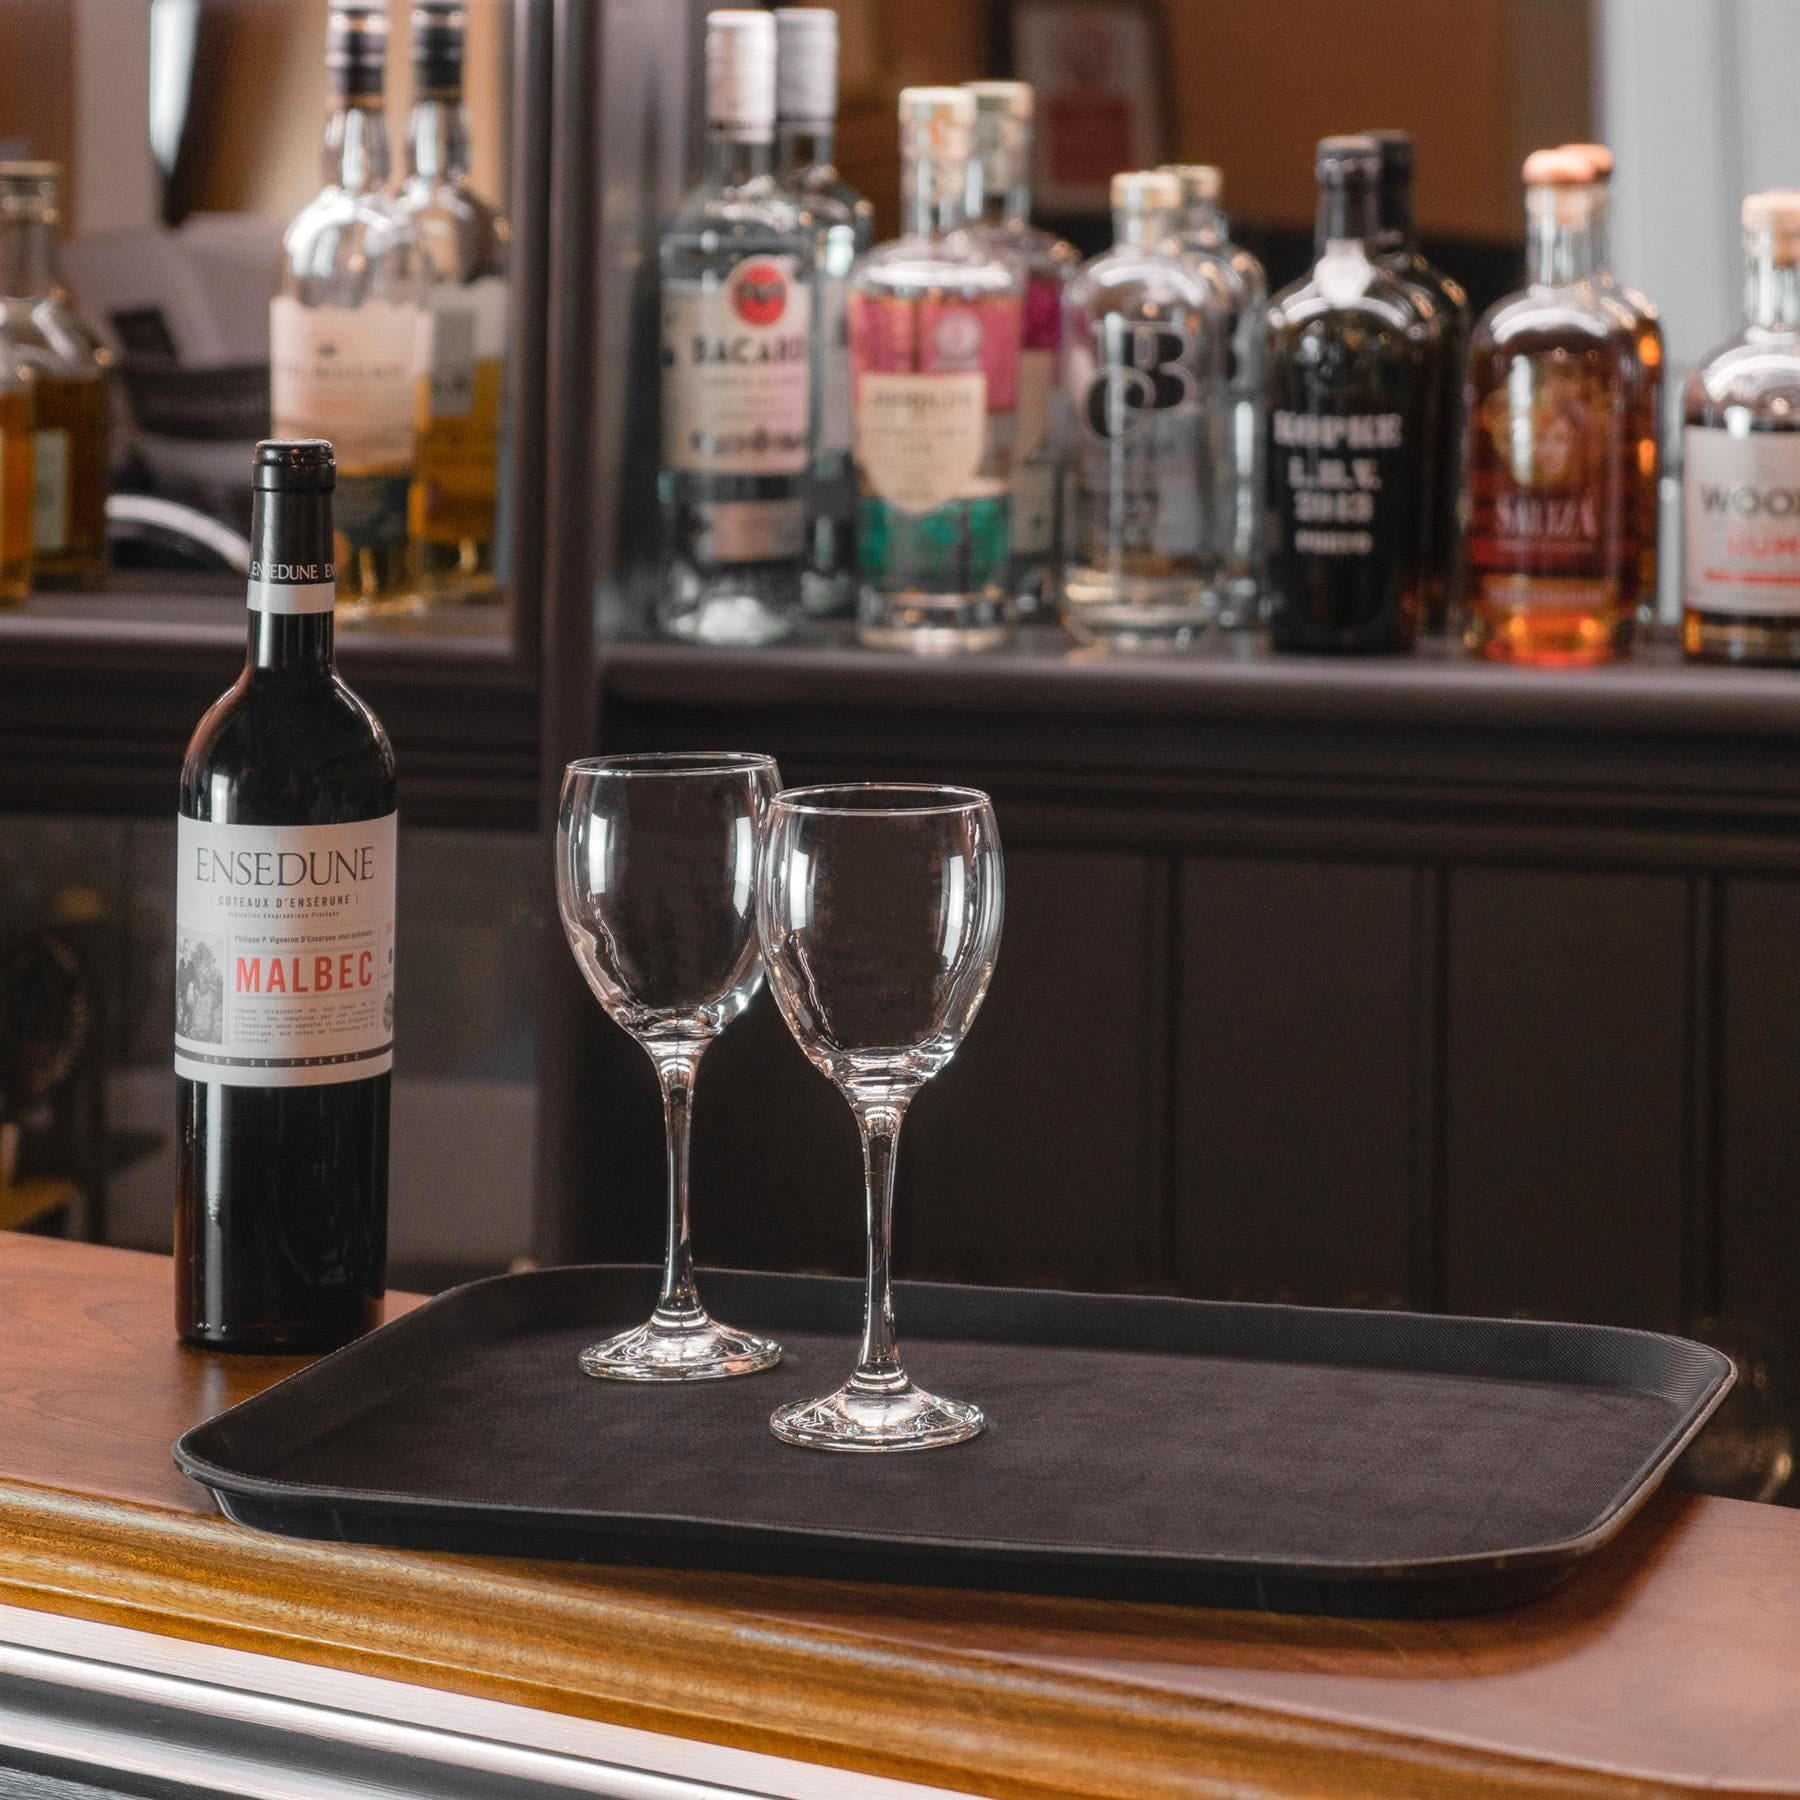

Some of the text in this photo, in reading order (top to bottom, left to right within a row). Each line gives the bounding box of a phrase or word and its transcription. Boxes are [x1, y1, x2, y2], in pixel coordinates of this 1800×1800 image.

[251, 560, 319, 580] ENEDUNE
[195, 846, 376, 887] ENSEDUNE
[218, 894, 350, 909] COTEAUX D'ENSÉRUNE
[236, 950, 373, 993] MALBEC
